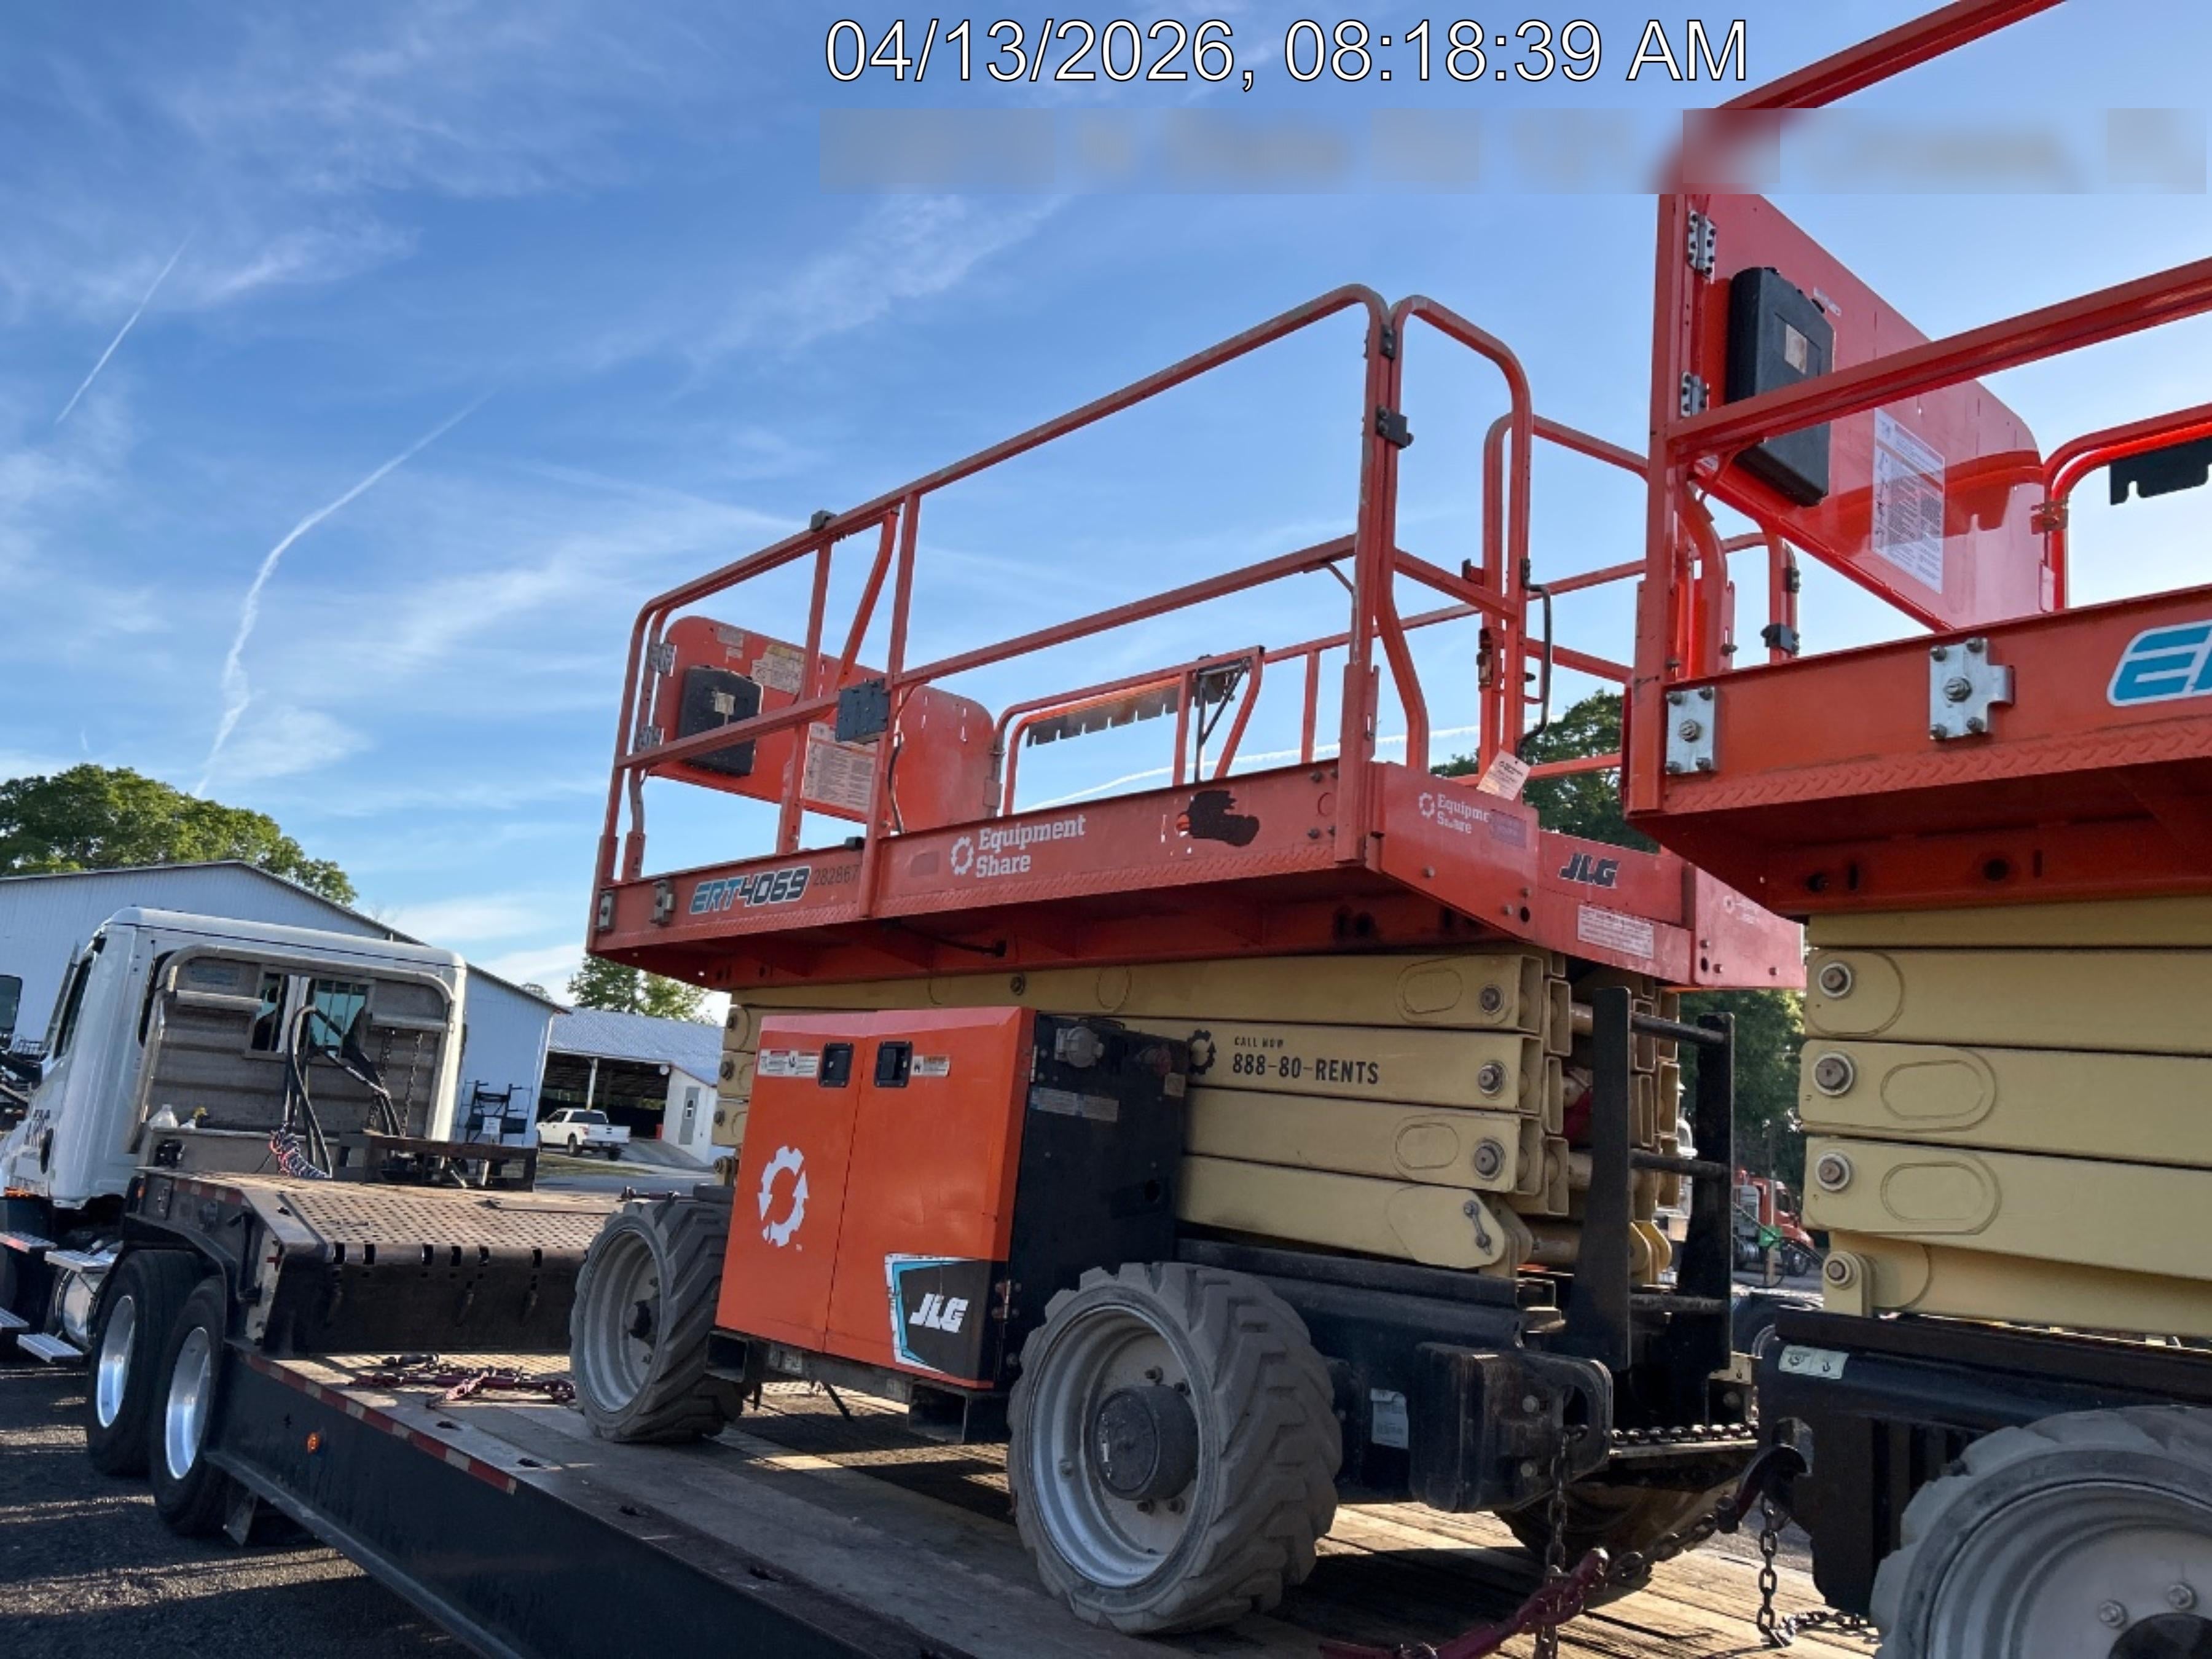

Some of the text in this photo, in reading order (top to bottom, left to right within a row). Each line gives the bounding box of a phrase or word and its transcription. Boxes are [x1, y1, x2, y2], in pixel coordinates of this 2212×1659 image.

[978, 814, 1087, 853] Equipment
[975, 854, 1032, 879] Share
[1558, 852, 1621, 888] JLG
[689, 866, 811, 914] ERT4069
[1234, 1035, 1258, 1048] CALL
[1232, 1052, 1379, 1085] 888-80-RENTS
[908, 1292, 969, 1333] JLG
